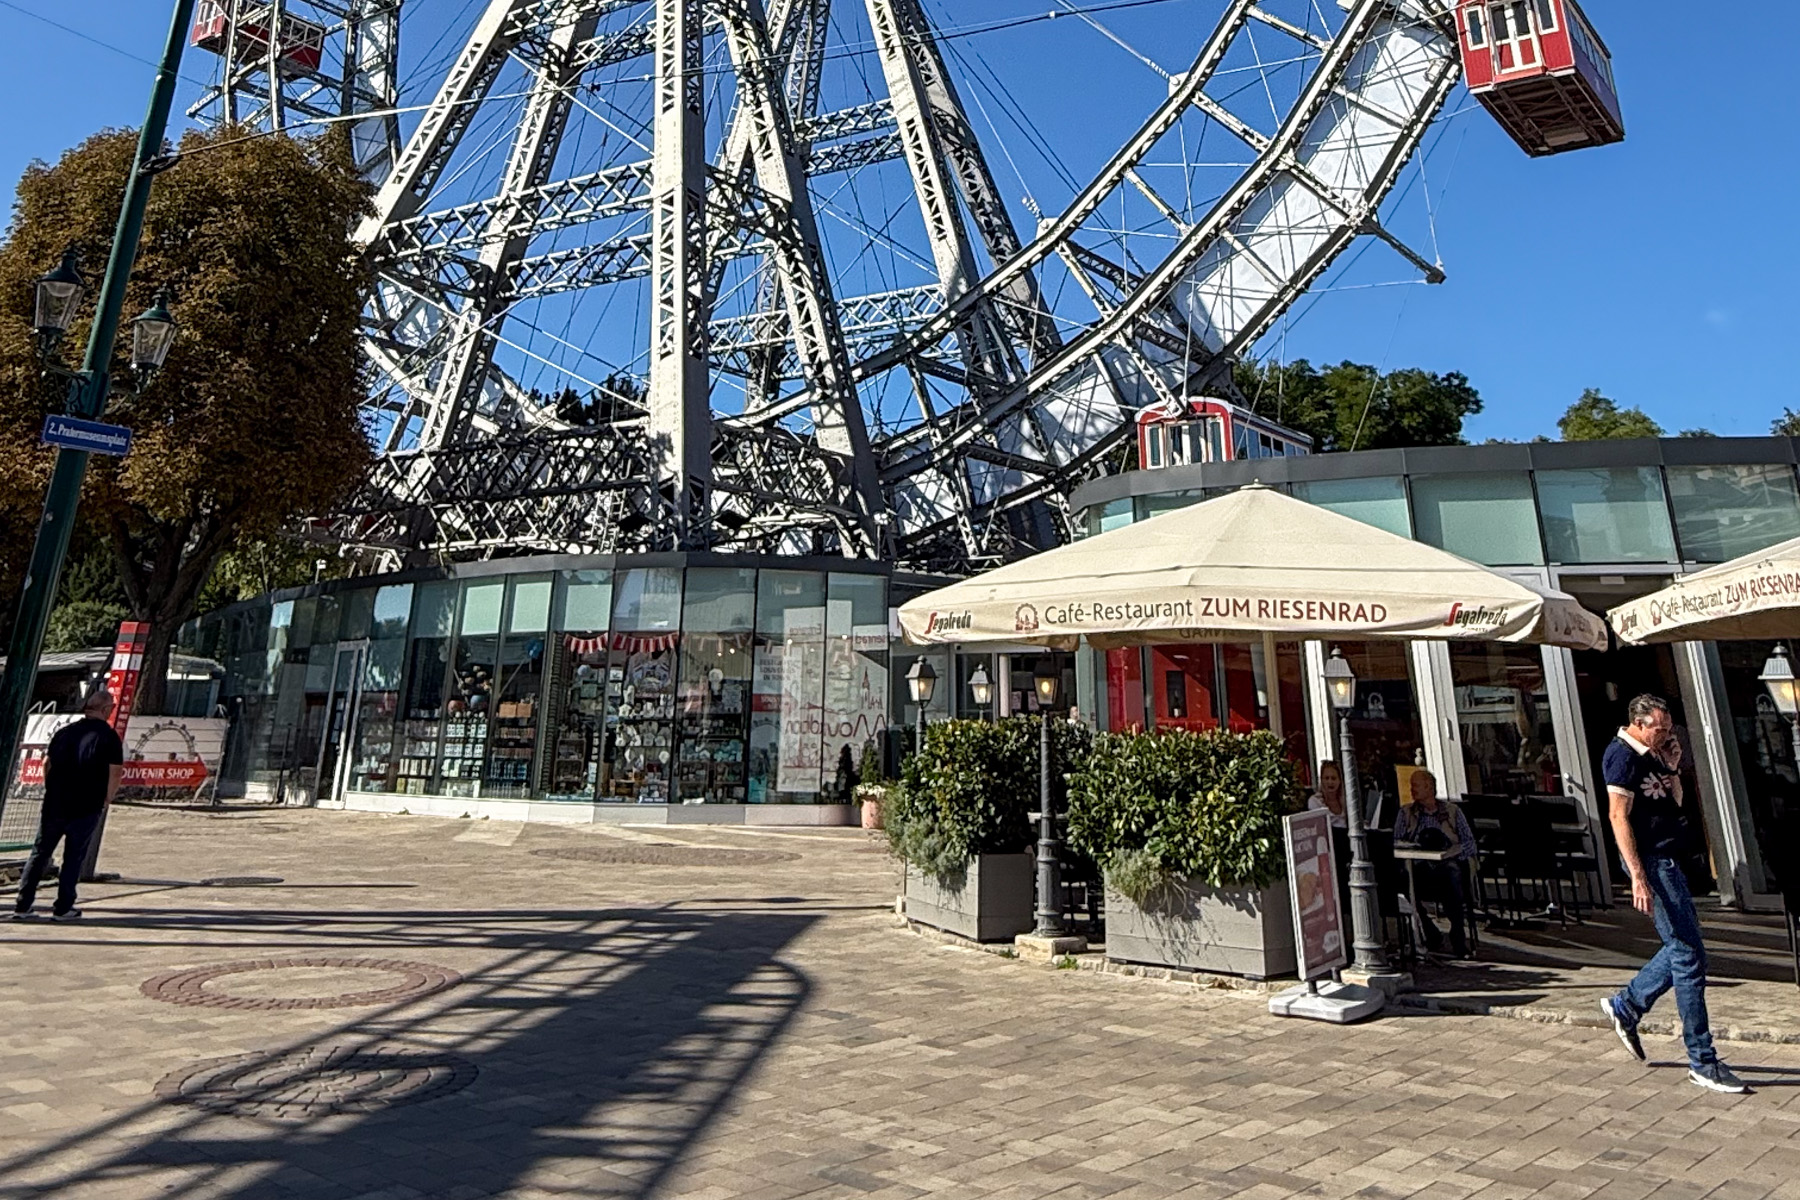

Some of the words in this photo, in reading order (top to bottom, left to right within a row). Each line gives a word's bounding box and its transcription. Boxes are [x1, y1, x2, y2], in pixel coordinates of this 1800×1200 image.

[1724, 581, 1749, 605] ZUM
[1045, 599, 1194, 626] Café-Restaurant
[1201, 597, 1251, 619] ZUM
[1257, 600, 1388, 624] RIESENRAD
[121, 767, 165, 779] OUVENIR
[166, 767, 195, 779] SHOP
